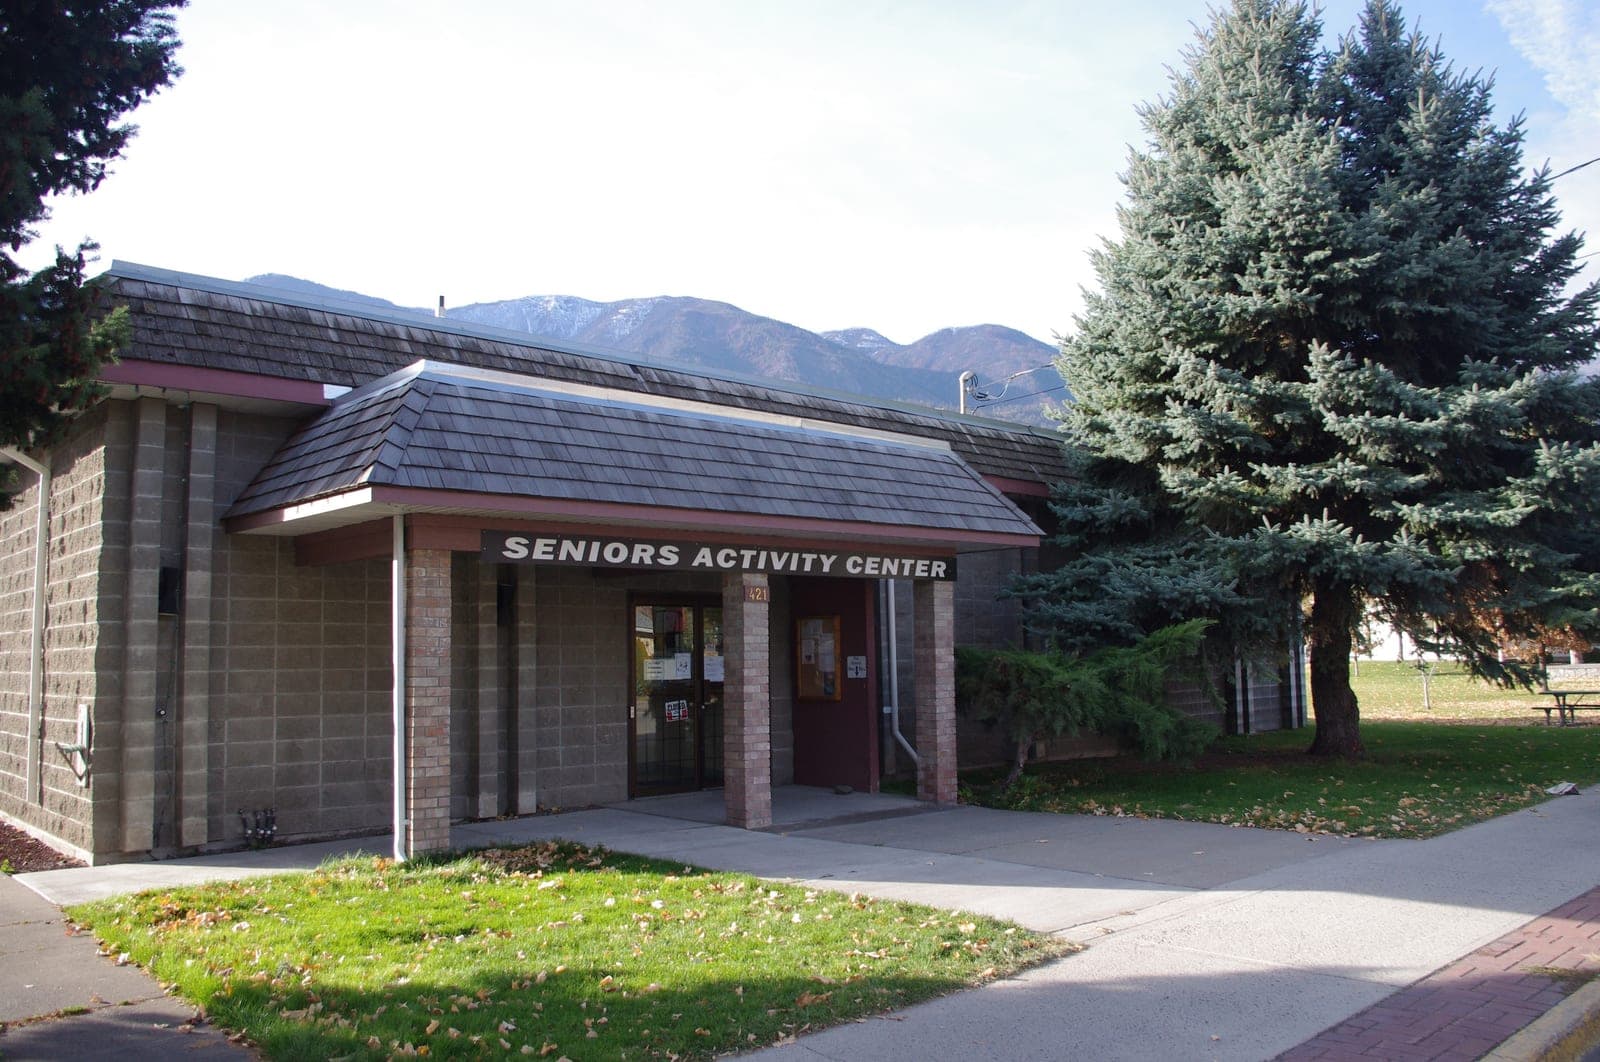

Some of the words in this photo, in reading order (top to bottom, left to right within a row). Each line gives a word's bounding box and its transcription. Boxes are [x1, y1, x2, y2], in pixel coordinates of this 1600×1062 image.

[502, 536, 680, 566] SENIORS
[691, 547, 837, 573] ACTIVITY
[846, 555, 947, 578] CENTER
[749, 587, 767, 601] 421
